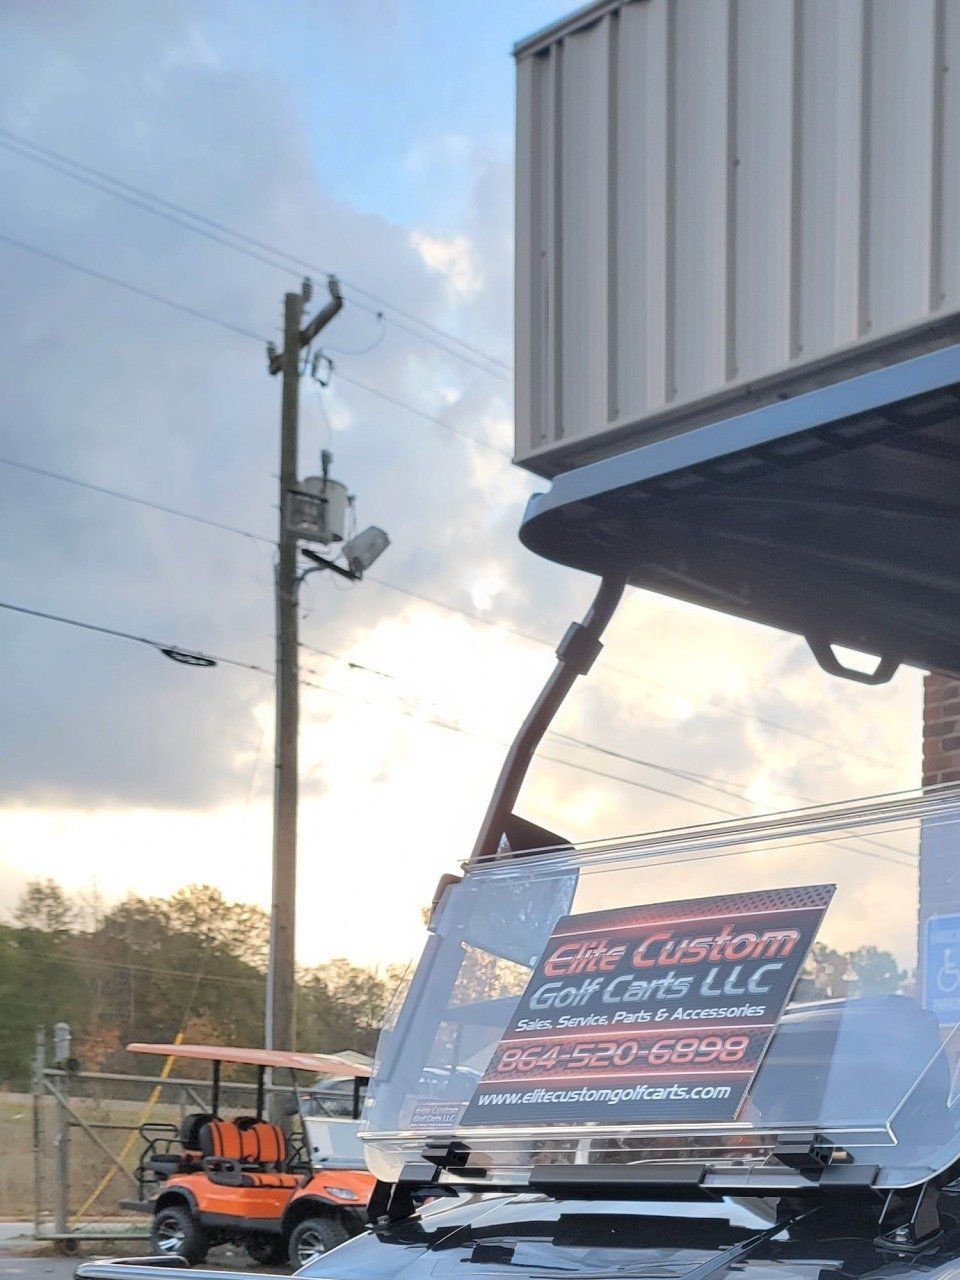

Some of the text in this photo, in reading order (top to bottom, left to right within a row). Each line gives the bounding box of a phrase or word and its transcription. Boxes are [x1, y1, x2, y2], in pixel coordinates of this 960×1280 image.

[544, 924, 800, 977] Elite Custom
[529, 962, 784, 1010] Golf Carts LLC
[515, 1003, 766, 1032] Sales, Service, Parts & Accessories
[496, 1035, 751, 1074] 864-520-6898
[478, 1083, 732, 1106] www.elitecustomgolfcarts.com
